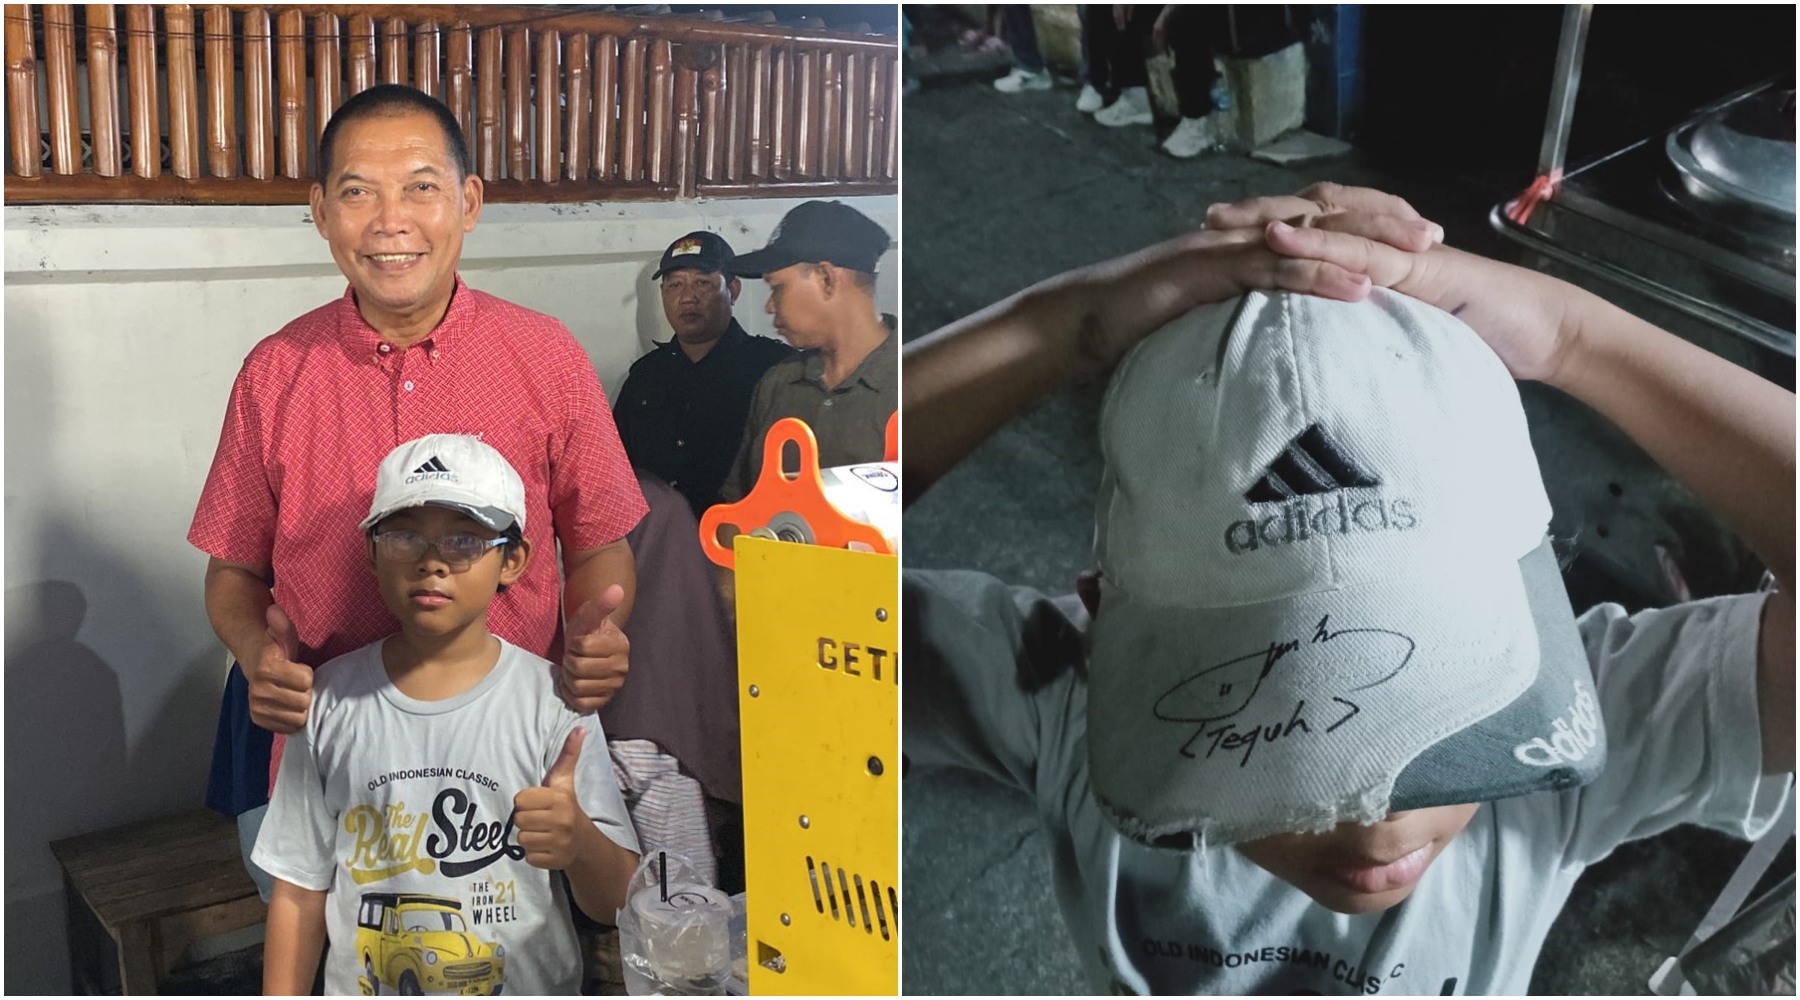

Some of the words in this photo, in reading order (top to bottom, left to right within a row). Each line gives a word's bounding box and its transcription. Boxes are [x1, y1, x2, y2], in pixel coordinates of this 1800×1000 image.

[405, 472, 459, 485] adidas
[1224, 492, 1419, 556] adidas
[367, 774, 387, 791] OLD
[389, 767, 453, 781] INDONESIAN
[455, 769, 499, 792] CLASSIC
[384, 801, 416, 829] The
[344, 803, 436, 885] Real
[426, 788, 526, 878] Steel
[472, 881, 489, 893] THE
[495, 880, 516, 904] 21
[472, 894, 494, 906] IRON
[473, 905, 517, 925] WHEEL
[1141, 938, 1182, 958] OLD
[1188, 946, 1330, 970] INDONESIAN
